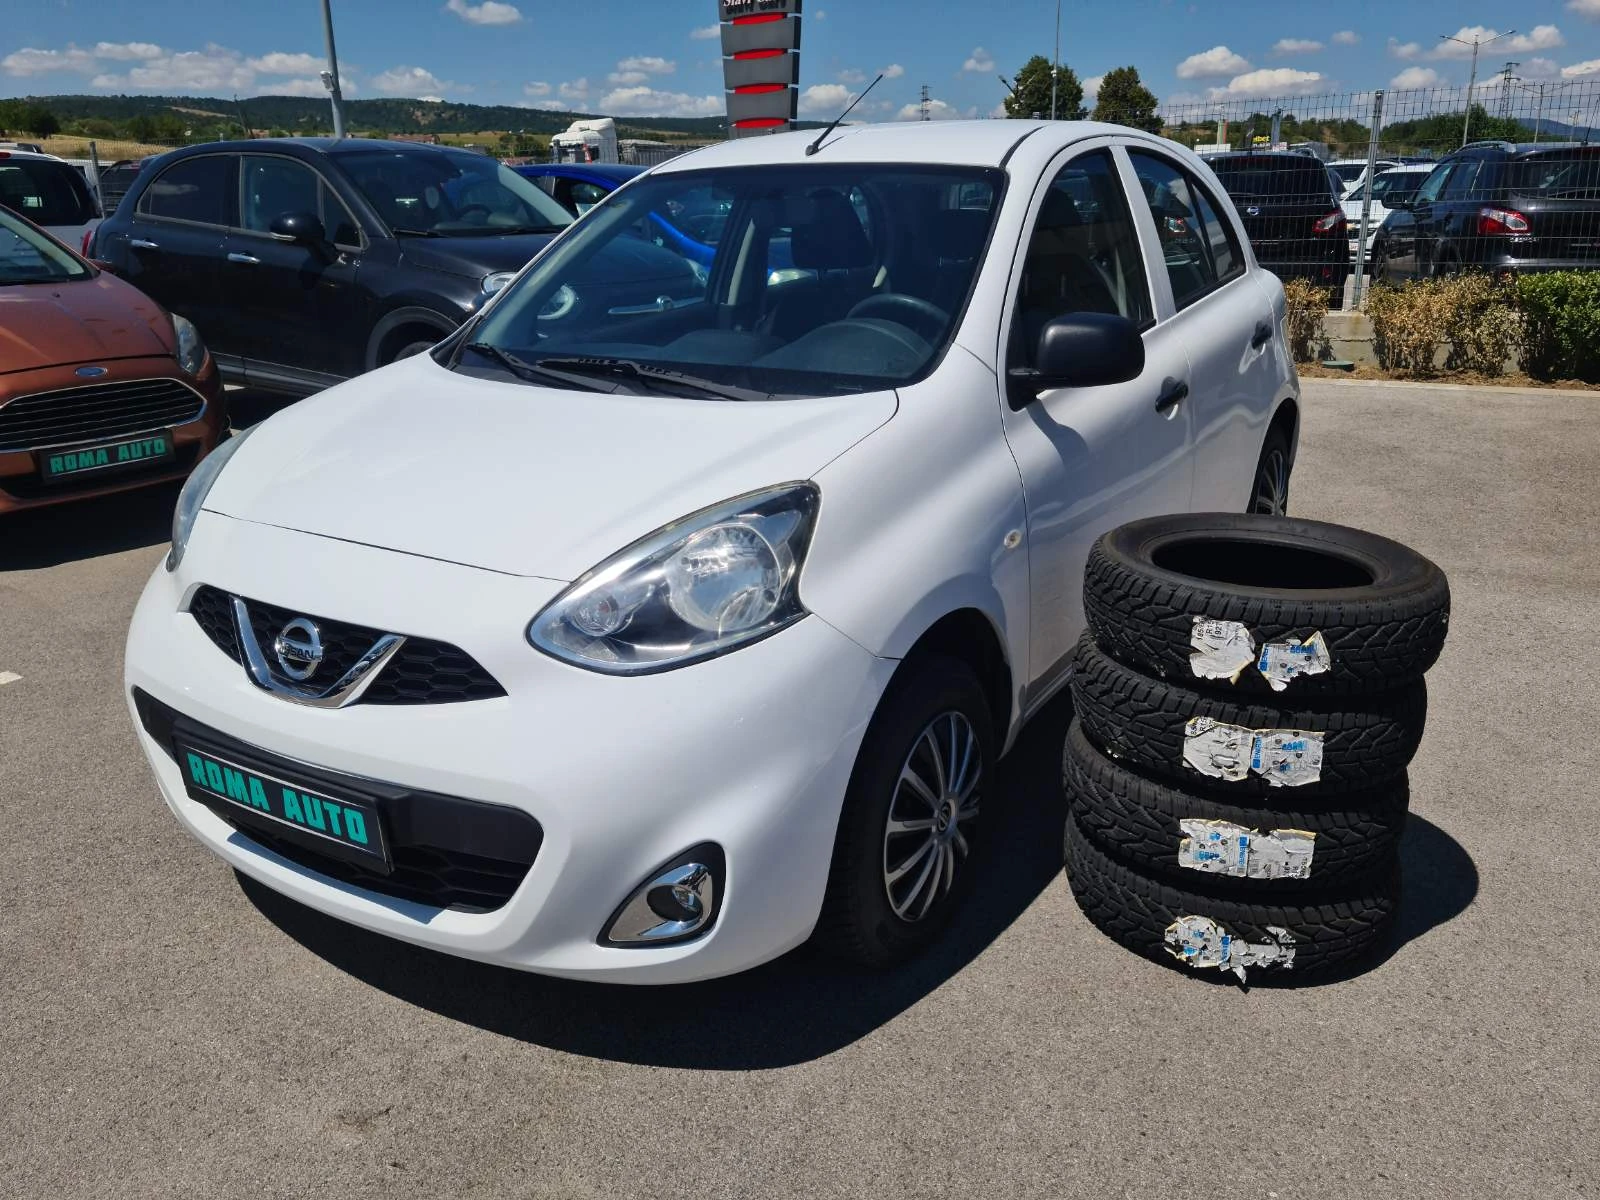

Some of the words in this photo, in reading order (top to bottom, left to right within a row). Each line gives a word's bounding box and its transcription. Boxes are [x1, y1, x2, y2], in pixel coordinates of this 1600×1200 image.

[50, 448, 109, 473] ROMA
[118, 438, 166, 461] AUTO
[279, 641, 314, 659] SSAN
[187, 752, 271, 812] ROMA
[282, 788, 368, 845] AUTO
